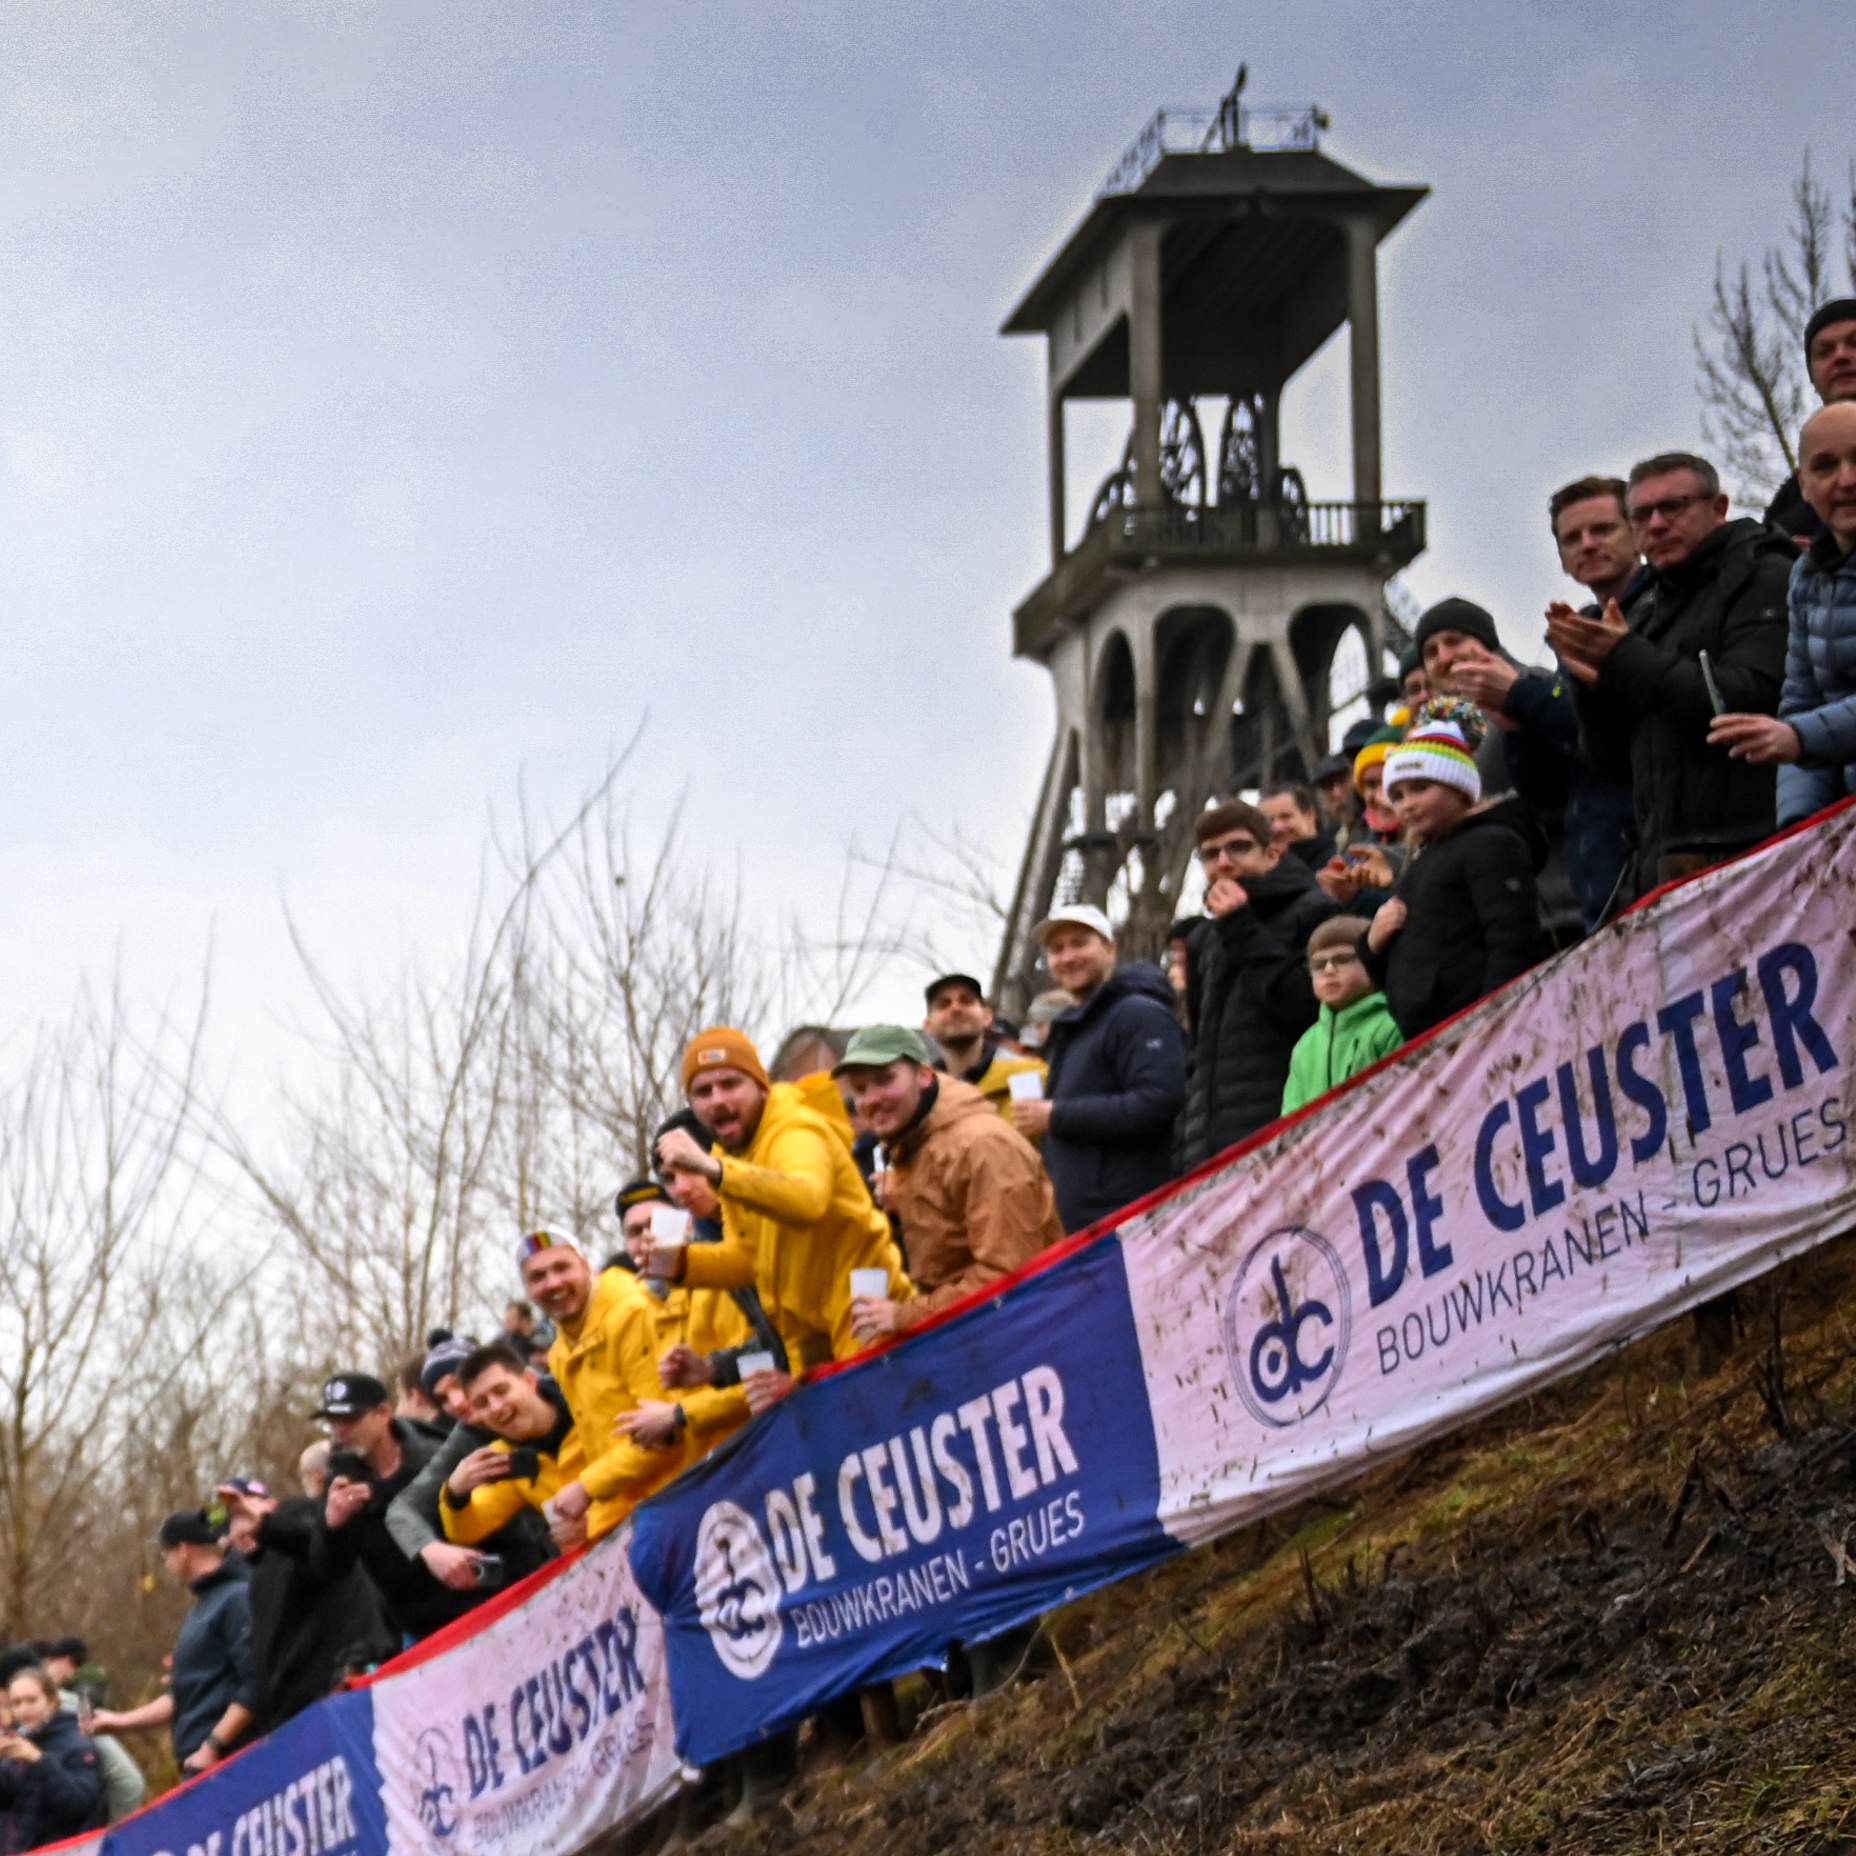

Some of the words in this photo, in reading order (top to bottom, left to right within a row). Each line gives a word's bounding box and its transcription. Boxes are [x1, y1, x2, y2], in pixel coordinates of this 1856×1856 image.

[1350, 1144, 1453, 1308] DE
[1473, 942, 1838, 1232] CEUSTER
[1375, 1191, 1649, 1375] BOUWKRANEN
[1692, 1097, 1846, 1209] GRUES
[763, 1473, 835, 1593] DE
[837, 1365, 1080, 1561] CEUSTER
[794, 1552, 972, 1649] BOUWKRANEN
[991, 1491, 1085, 1573] GRUES
[460, 1701, 505, 1799] DE
[509, 1604, 649, 1771] CEUSTER
